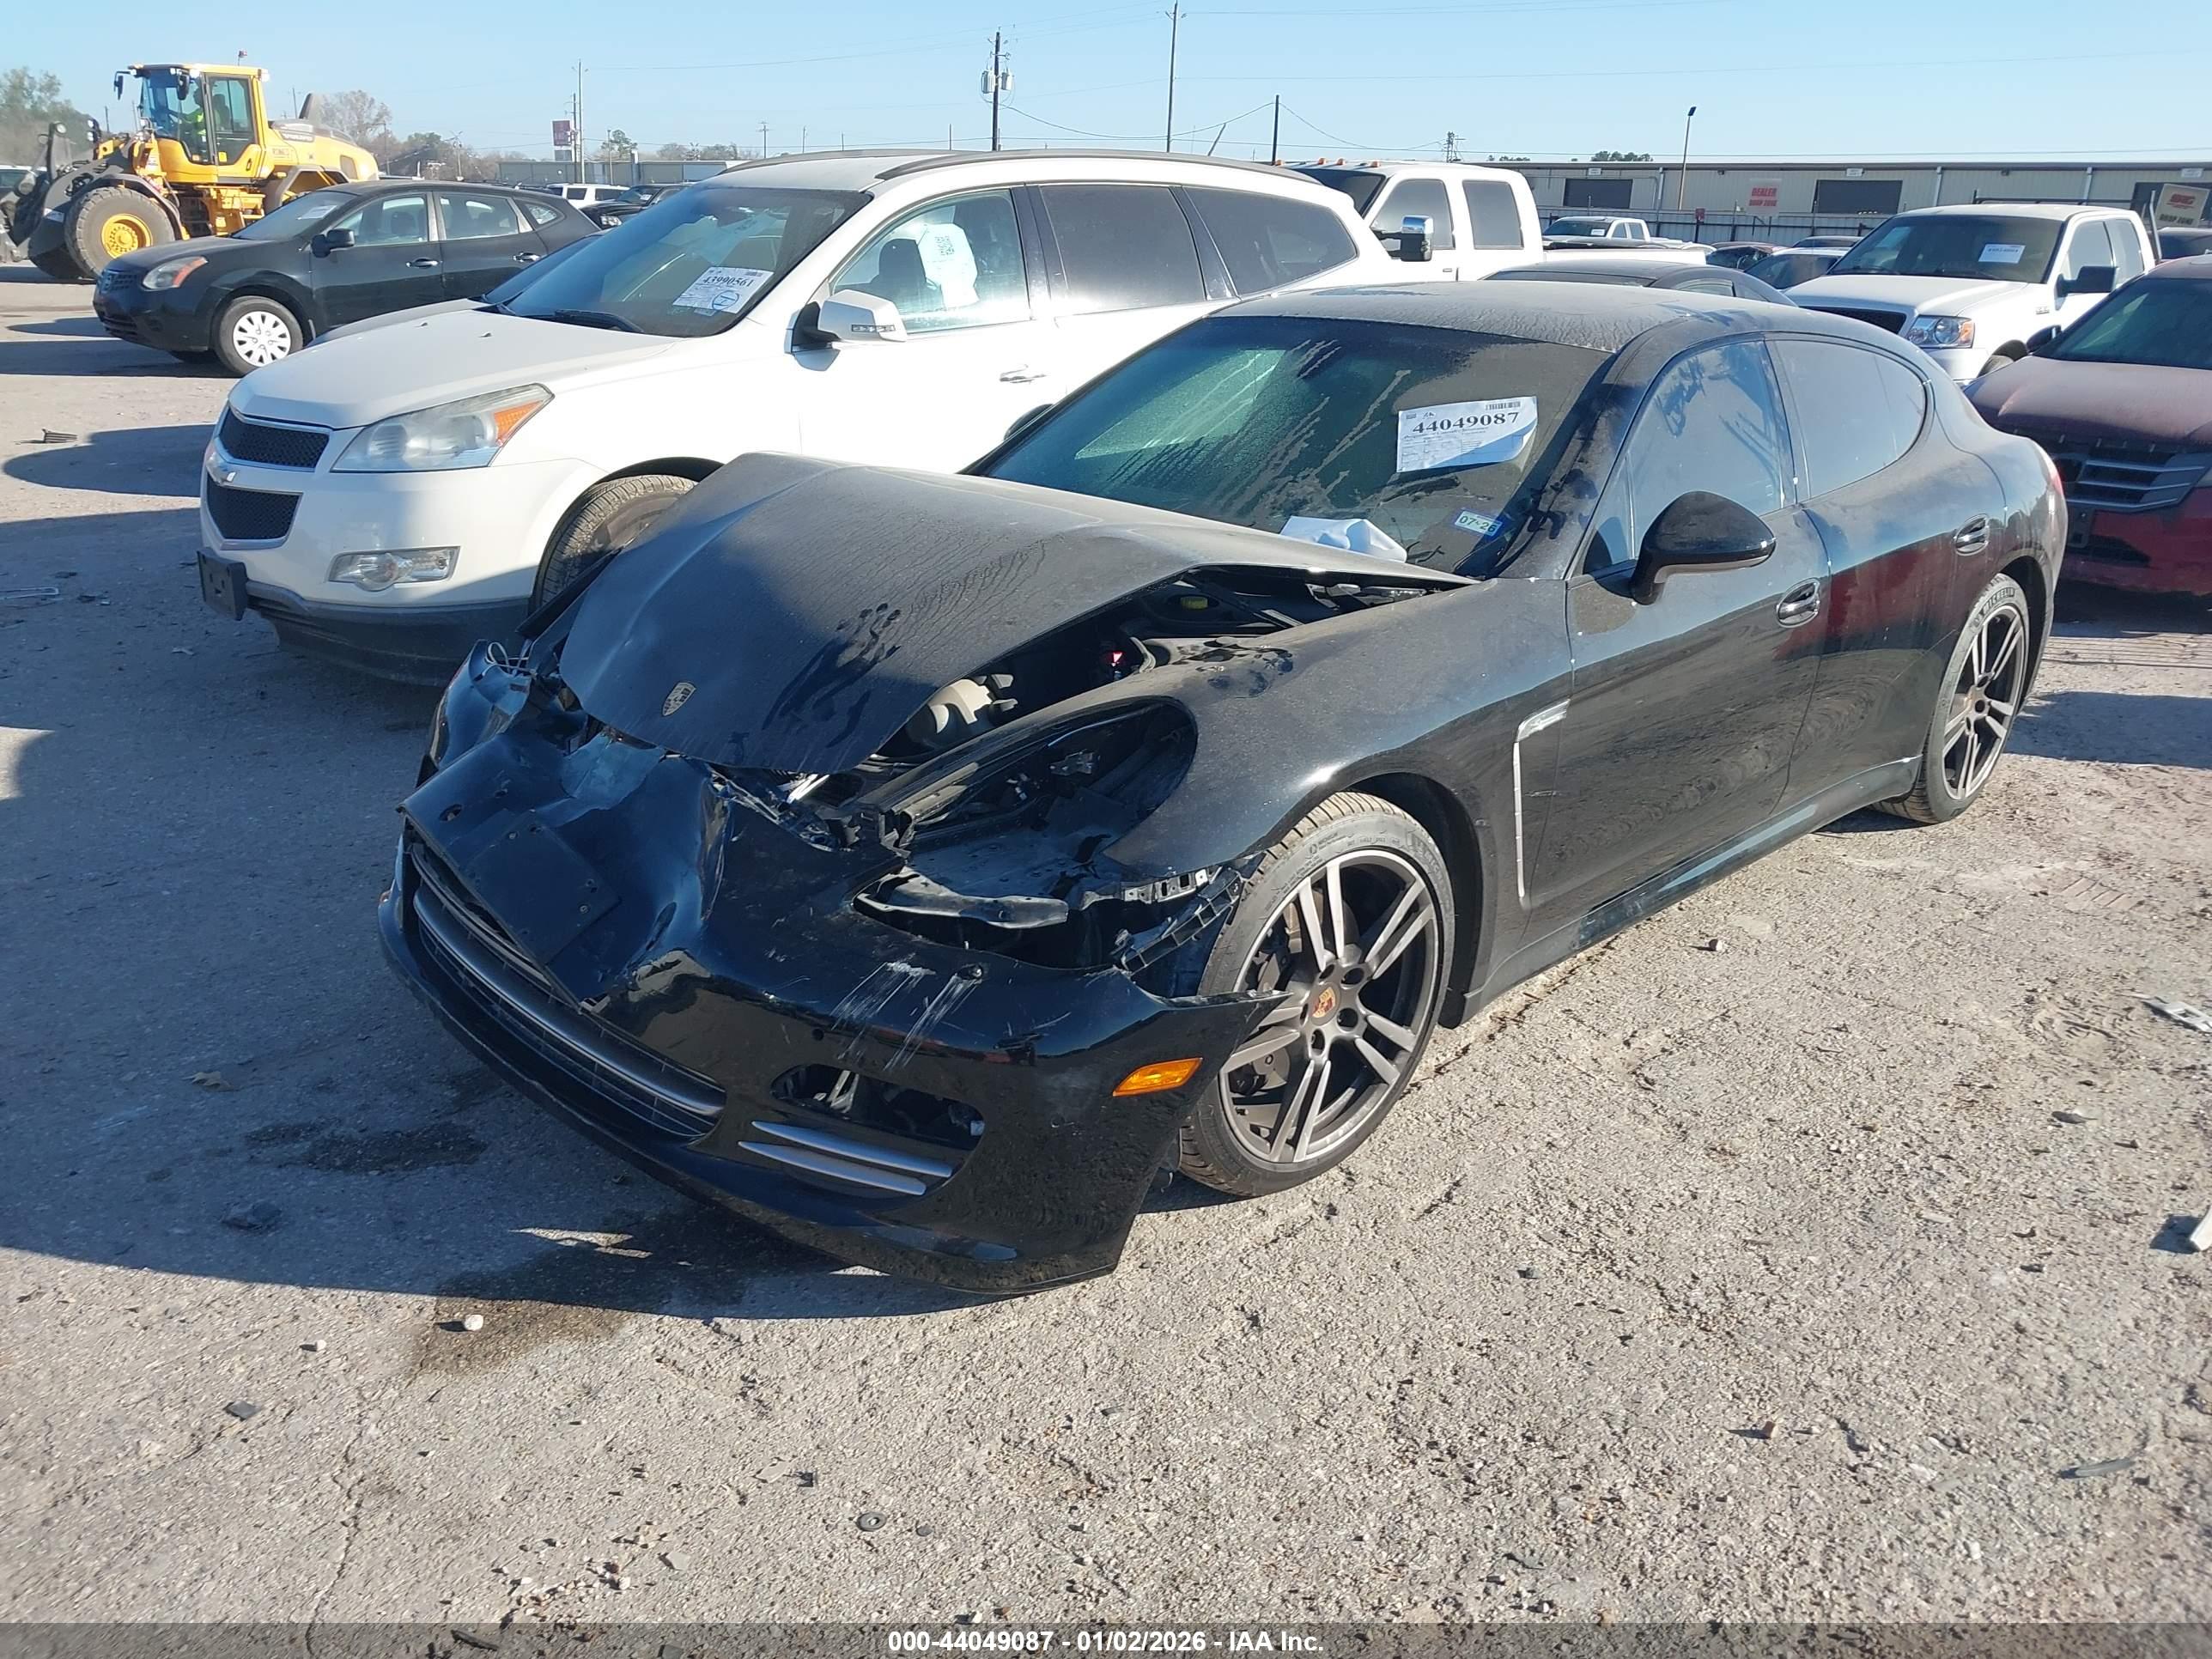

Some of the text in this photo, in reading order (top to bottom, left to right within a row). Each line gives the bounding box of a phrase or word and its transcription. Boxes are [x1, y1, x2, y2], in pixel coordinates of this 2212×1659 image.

[1752, 187, 1777, 197] DEALER
[703, 276, 753, 287] 43990561
[1413, 411, 1519, 433] 44049087
